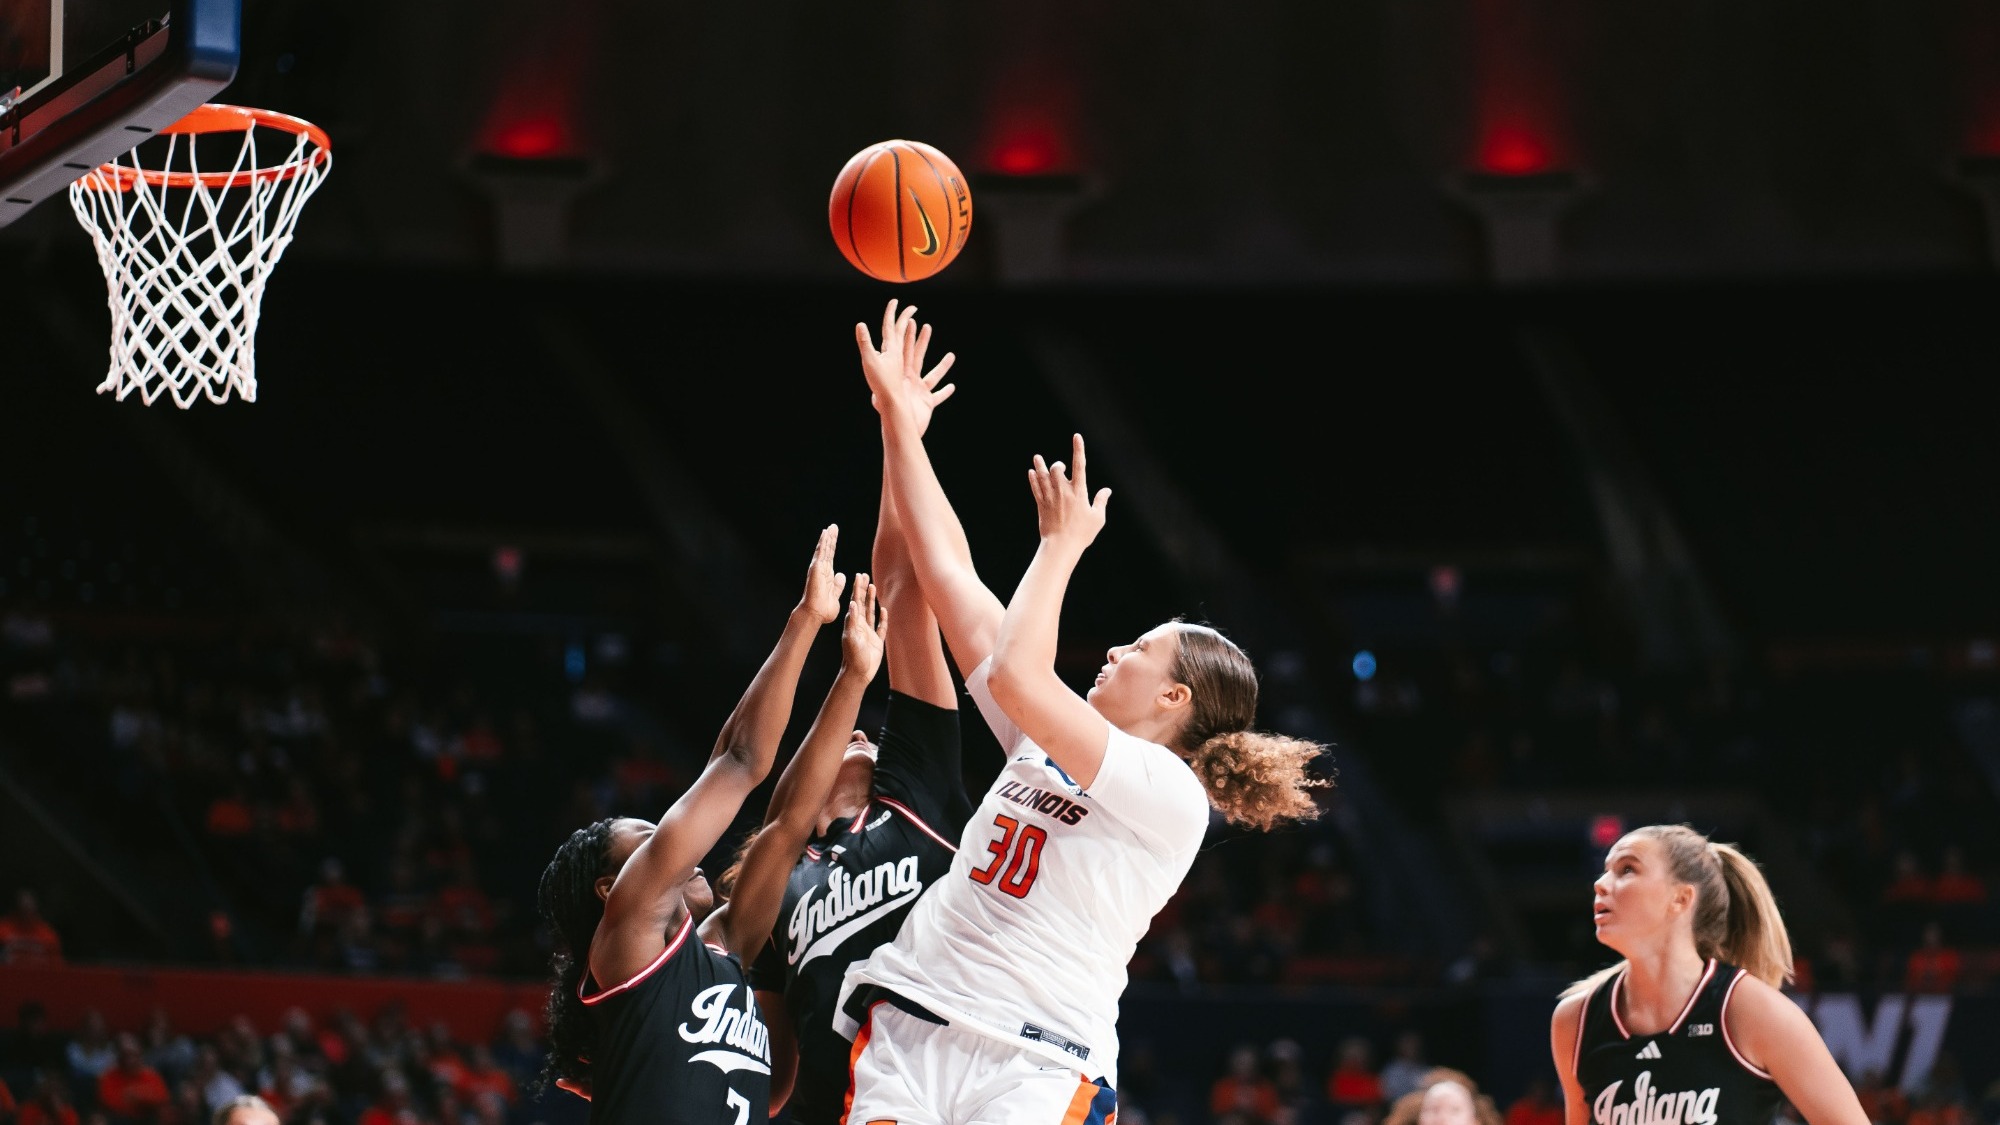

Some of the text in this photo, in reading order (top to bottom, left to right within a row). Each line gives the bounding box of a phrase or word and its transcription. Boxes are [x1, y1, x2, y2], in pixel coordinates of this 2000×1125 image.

[996, 781, 1089, 826] ILLINOIS
[969, 813, 1047, 899] 30
[787, 855, 922, 966] Indiana
[726, 1086, 751, 1125] 7
[1593, 1070, 1721, 1125] Indiana
